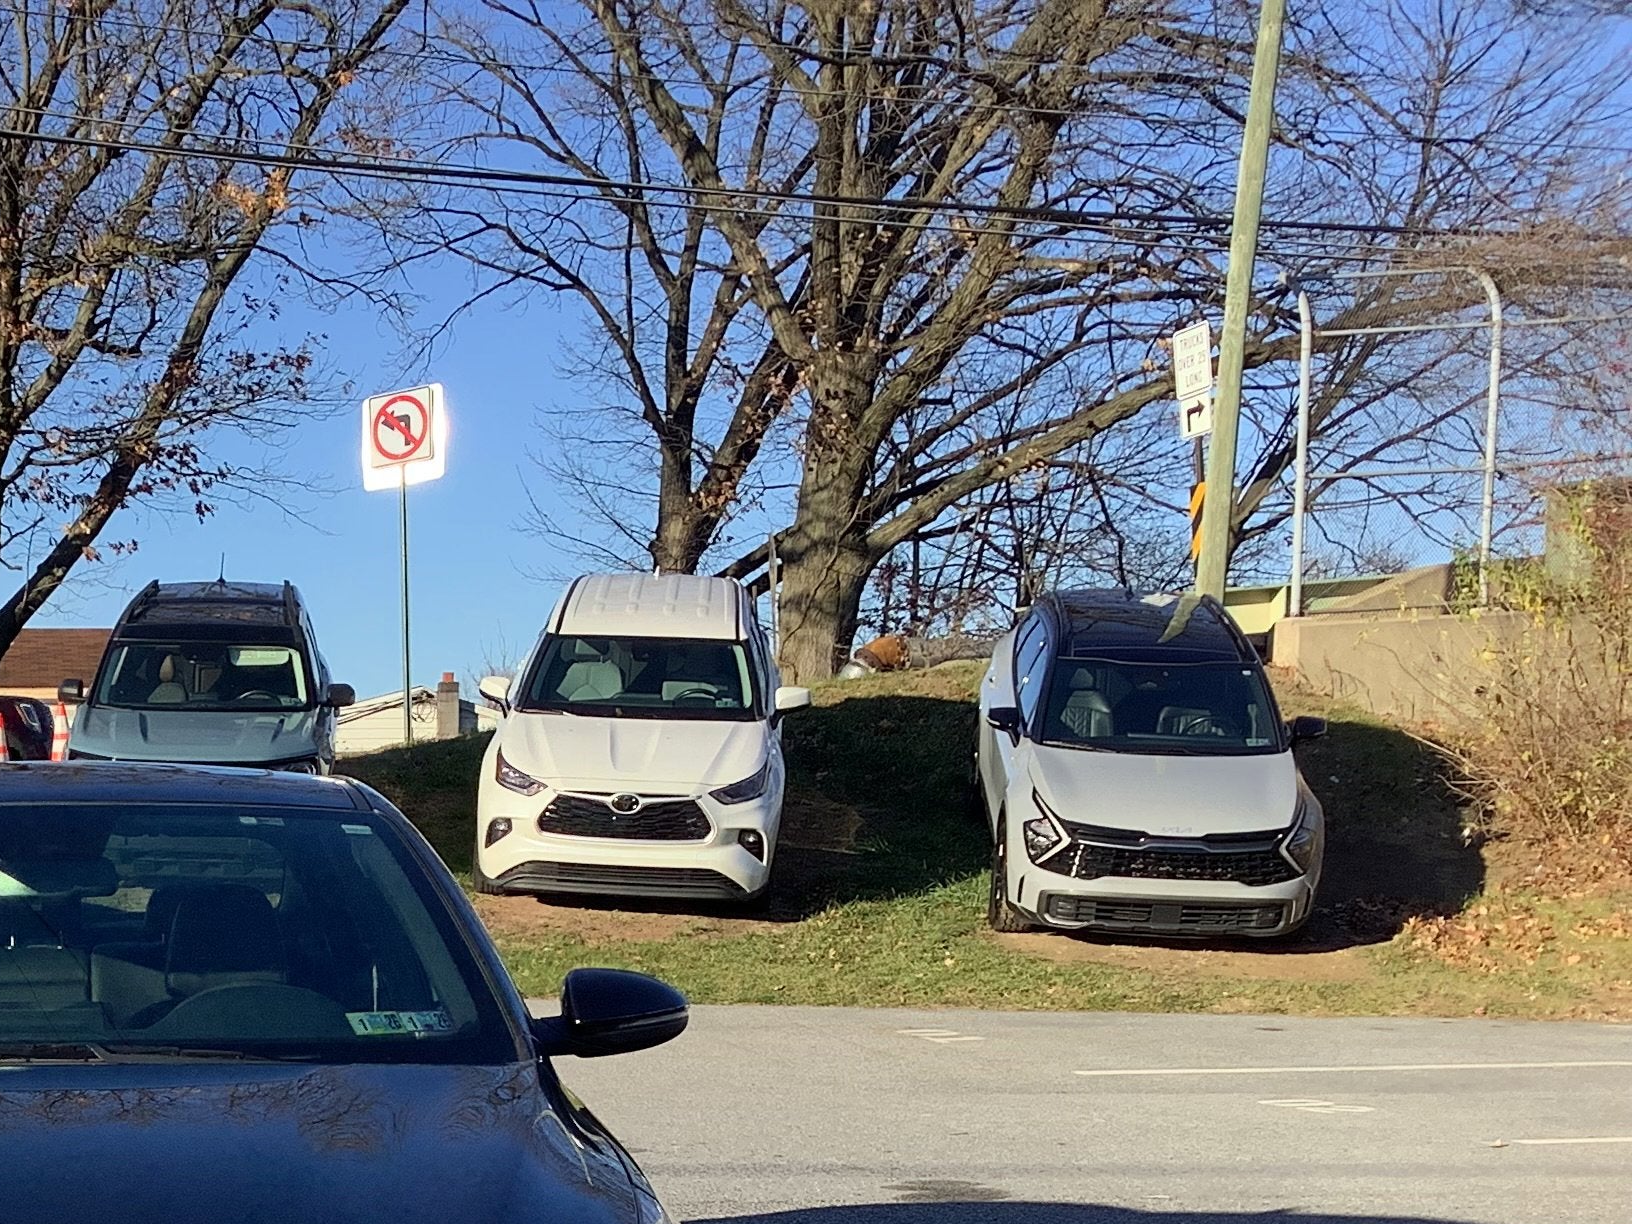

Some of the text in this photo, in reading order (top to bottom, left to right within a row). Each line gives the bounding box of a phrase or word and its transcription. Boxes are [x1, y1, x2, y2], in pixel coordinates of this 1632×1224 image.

[1180, 332, 1204, 352] TRUCKS
[1178, 353, 1195, 371] OVER
[1185, 370, 1203, 388] LONG
[358, 1013, 403, 1032] 1 26
